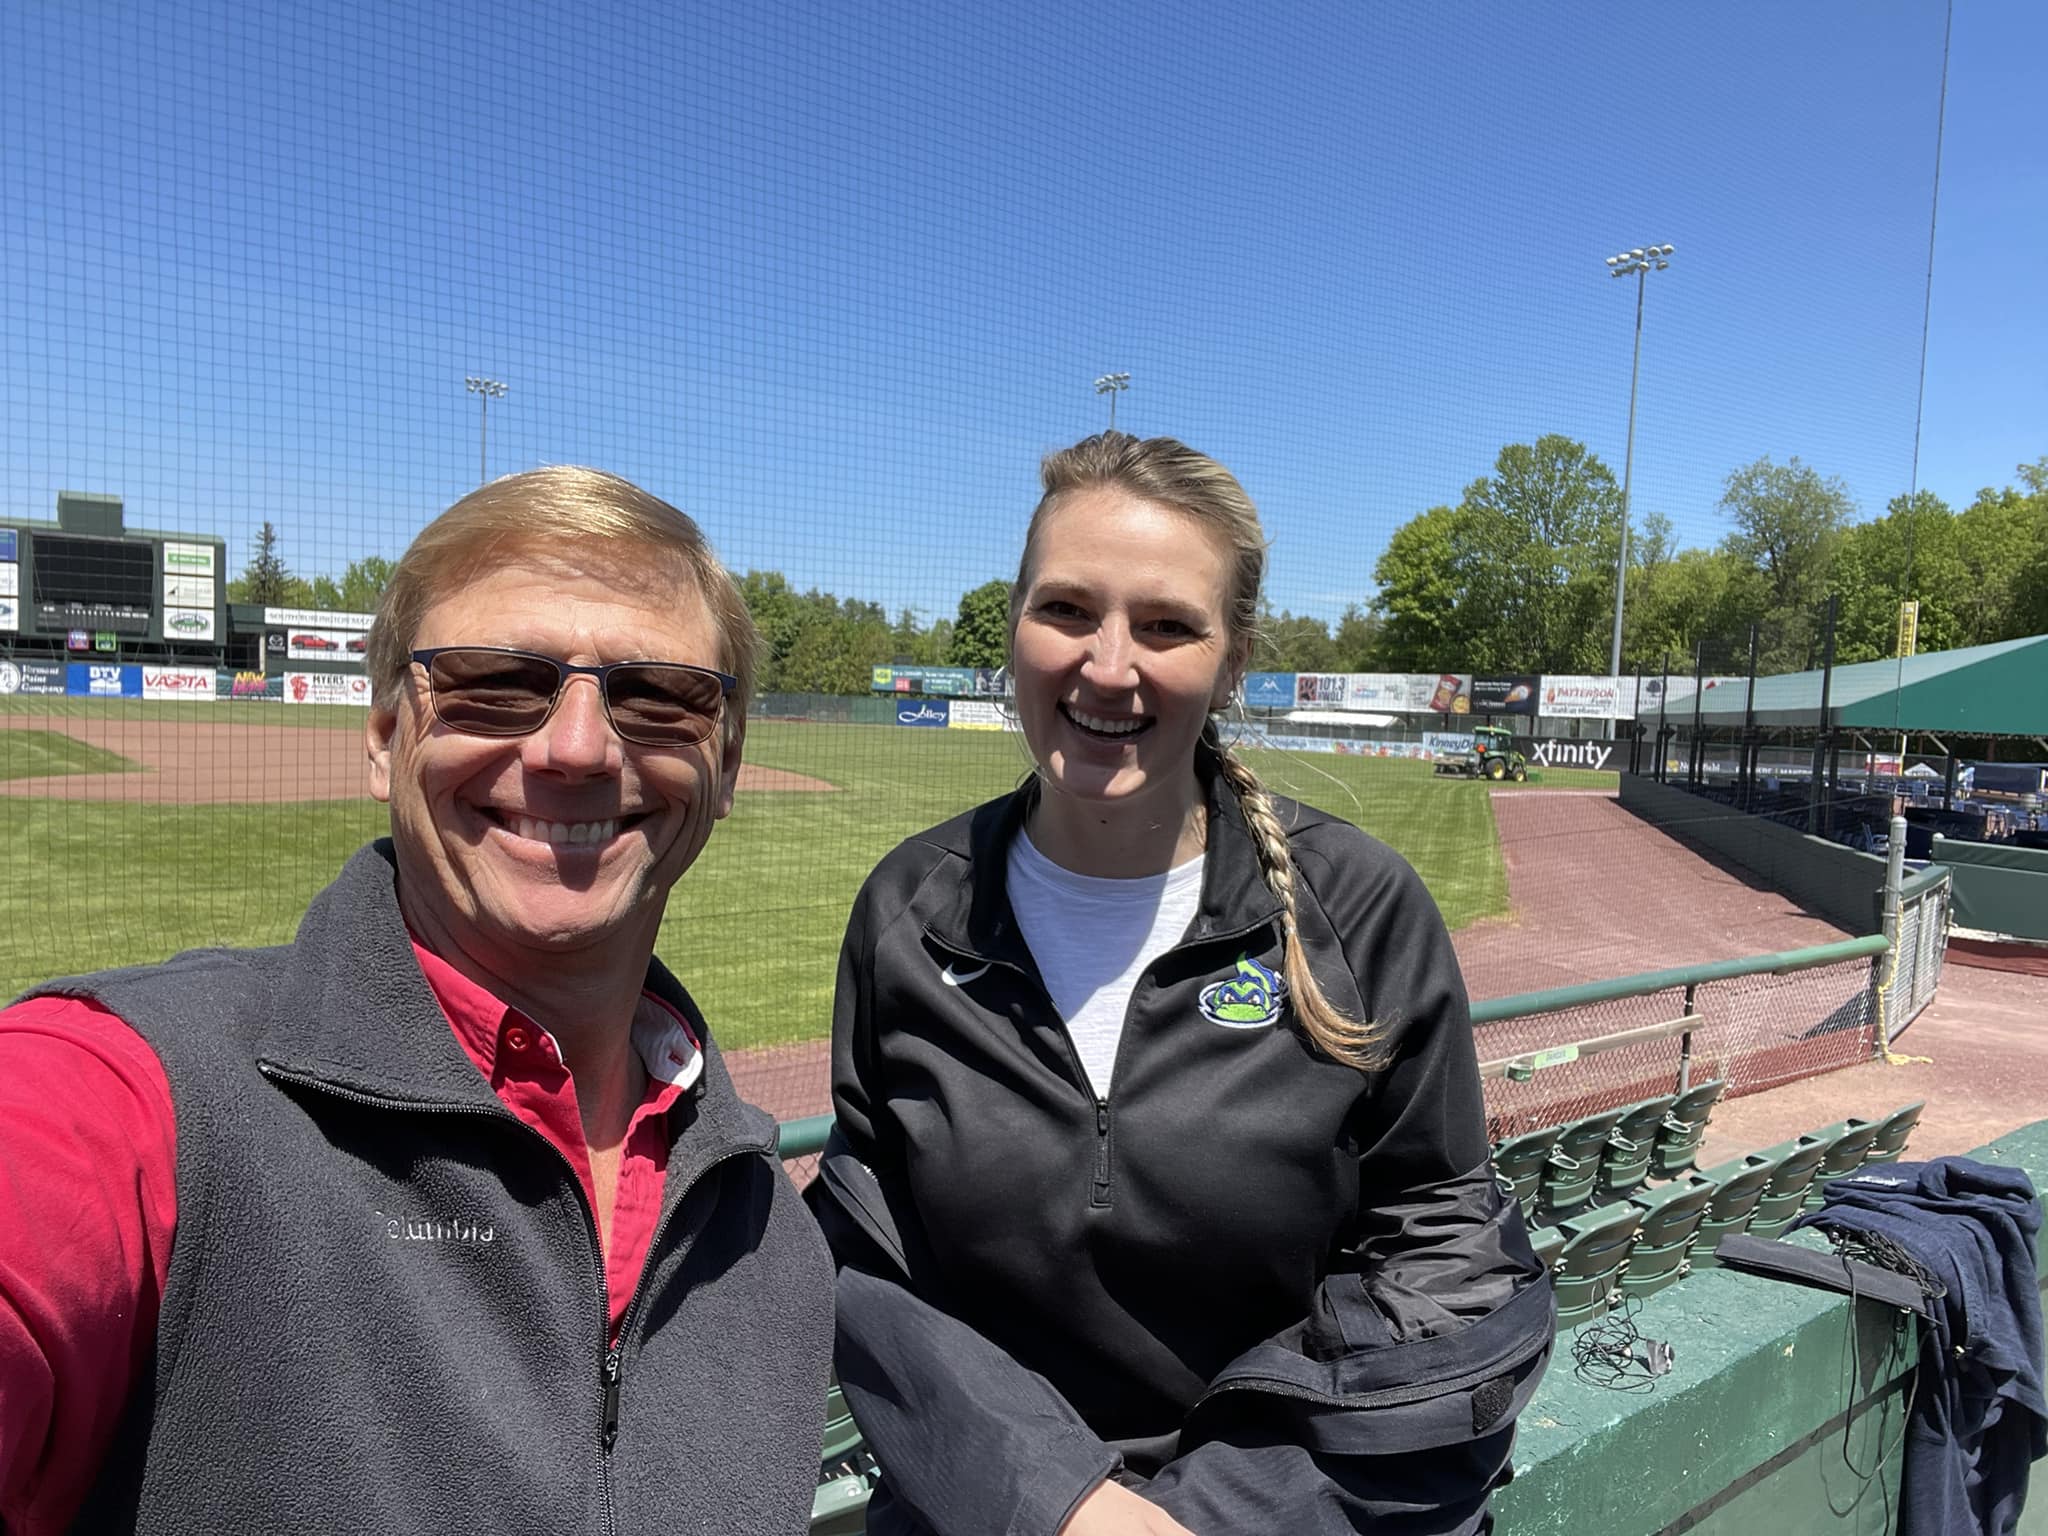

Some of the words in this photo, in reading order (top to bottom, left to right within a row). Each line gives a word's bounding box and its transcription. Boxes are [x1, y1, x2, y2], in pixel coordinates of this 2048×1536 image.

[22, 674, 46, 683] Paint
[89, 666, 121, 680] BTV
[312, 675, 345, 685] MYERS
[21, 683, 64, 694] Company
[1319, 676, 1345, 690] 101.3
[1557, 686, 1614, 699] PATTERSON
[898, 703, 947, 722] Jolley
[1532, 739, 1613, 770] xfinity
[375, 1211, 494, 1242] olumbia
